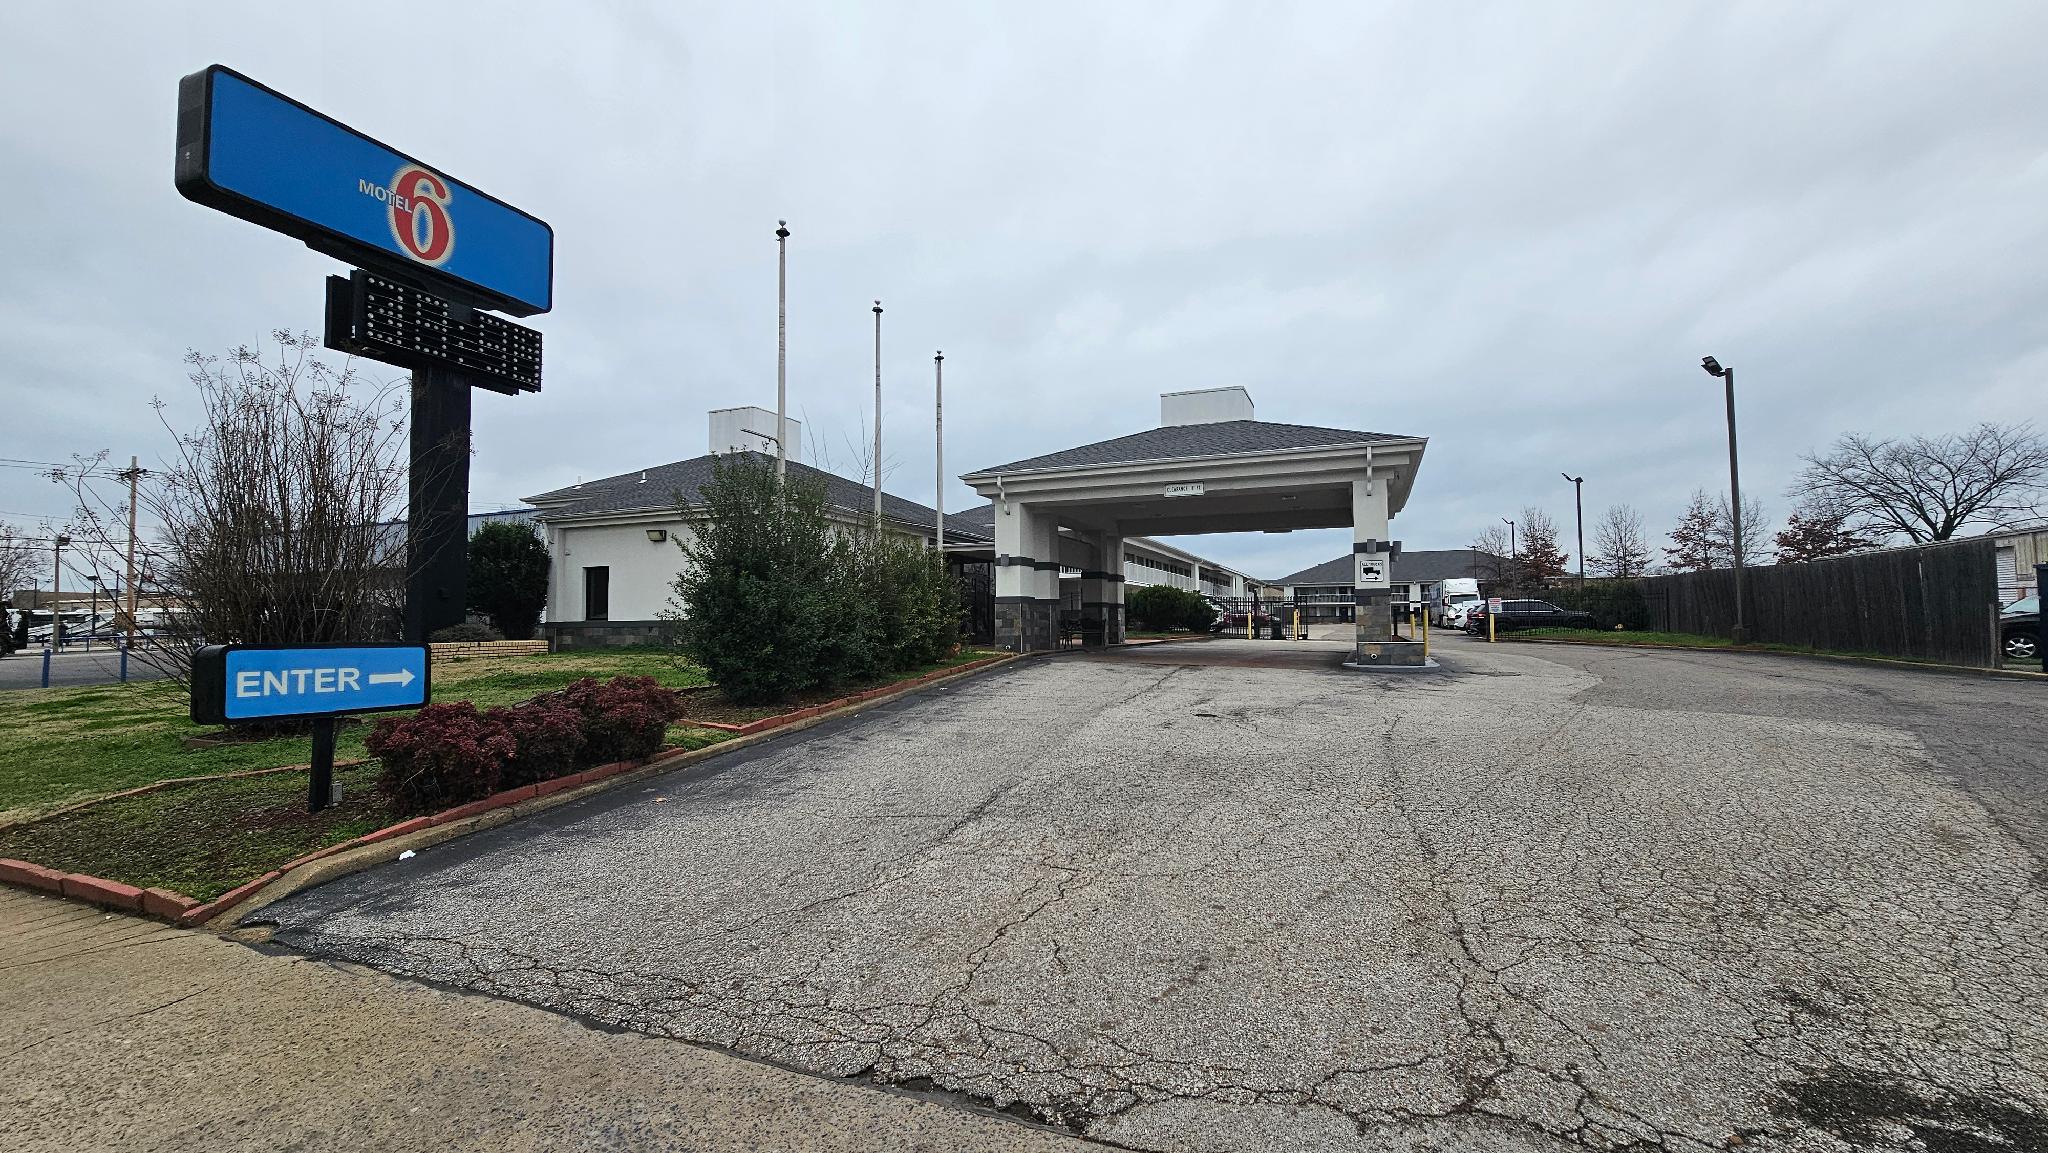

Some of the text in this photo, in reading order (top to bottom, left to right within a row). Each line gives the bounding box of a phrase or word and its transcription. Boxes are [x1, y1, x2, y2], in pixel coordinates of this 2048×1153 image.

[359, 166, 454, 266] MOTEL 6
[236, 667, 361, 698] ENTER
